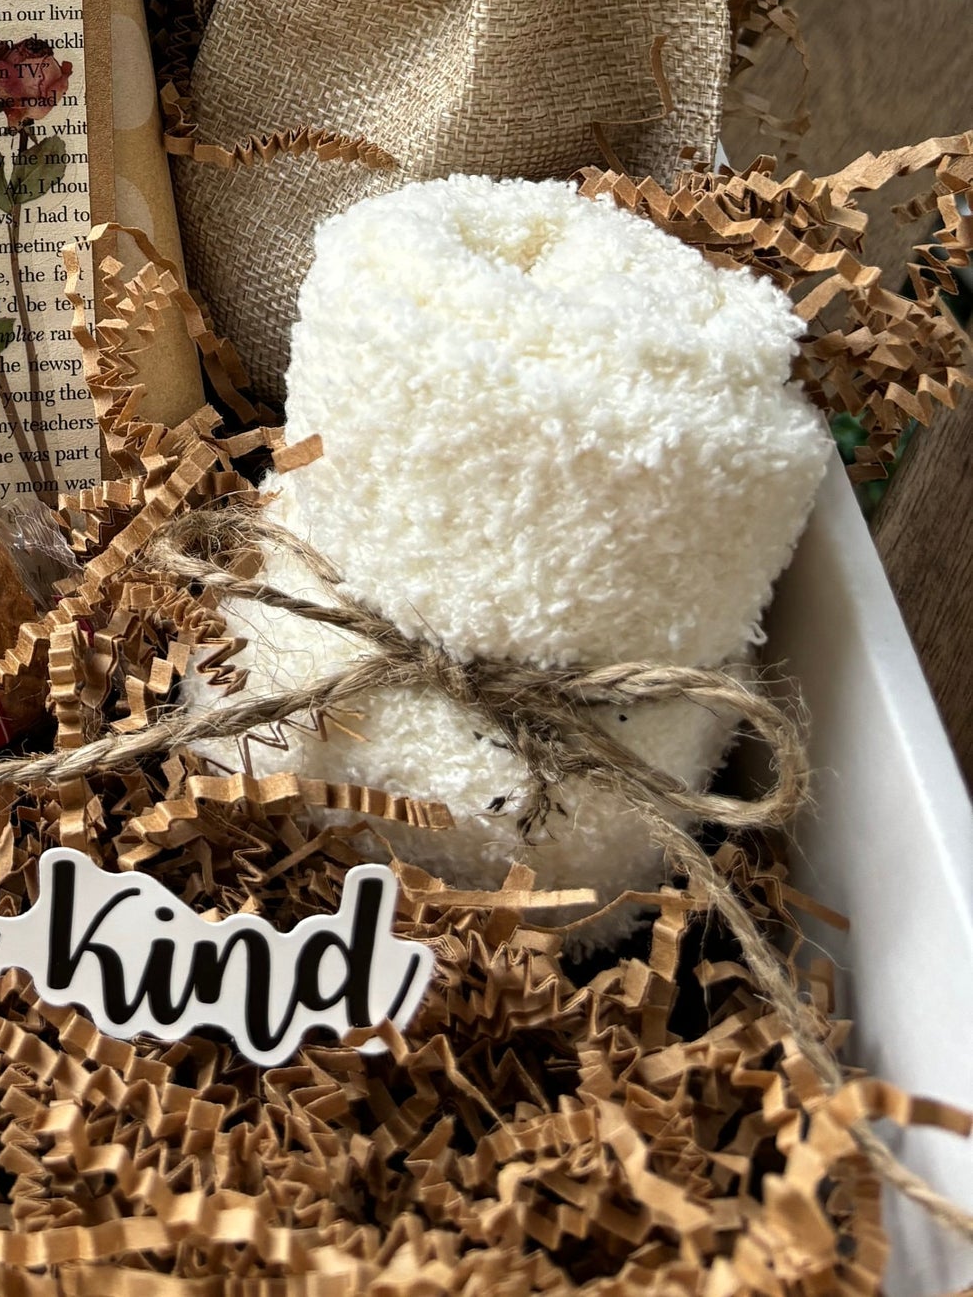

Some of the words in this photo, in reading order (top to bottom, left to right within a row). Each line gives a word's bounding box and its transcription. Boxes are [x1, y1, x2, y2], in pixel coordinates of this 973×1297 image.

[17, 11, 45, 21] our
[20, 92, 57, 107] road
[63, 92, 78, 106] in
[12, 151, 37, 166] the
[5, 182, 33, 198] Ah,
[39, 179, 44, 194] I
[25, 209, 31, 223] I
[37, 206, 68, 223] had
[74, 209, 89, 222] to
[19, 267, 45, 282] the
[27, 296, 47, 312] be
[55, 446, 88, 466] part
[65, 479, 95, 490] was
[46, 858, 420, 1052] kind
